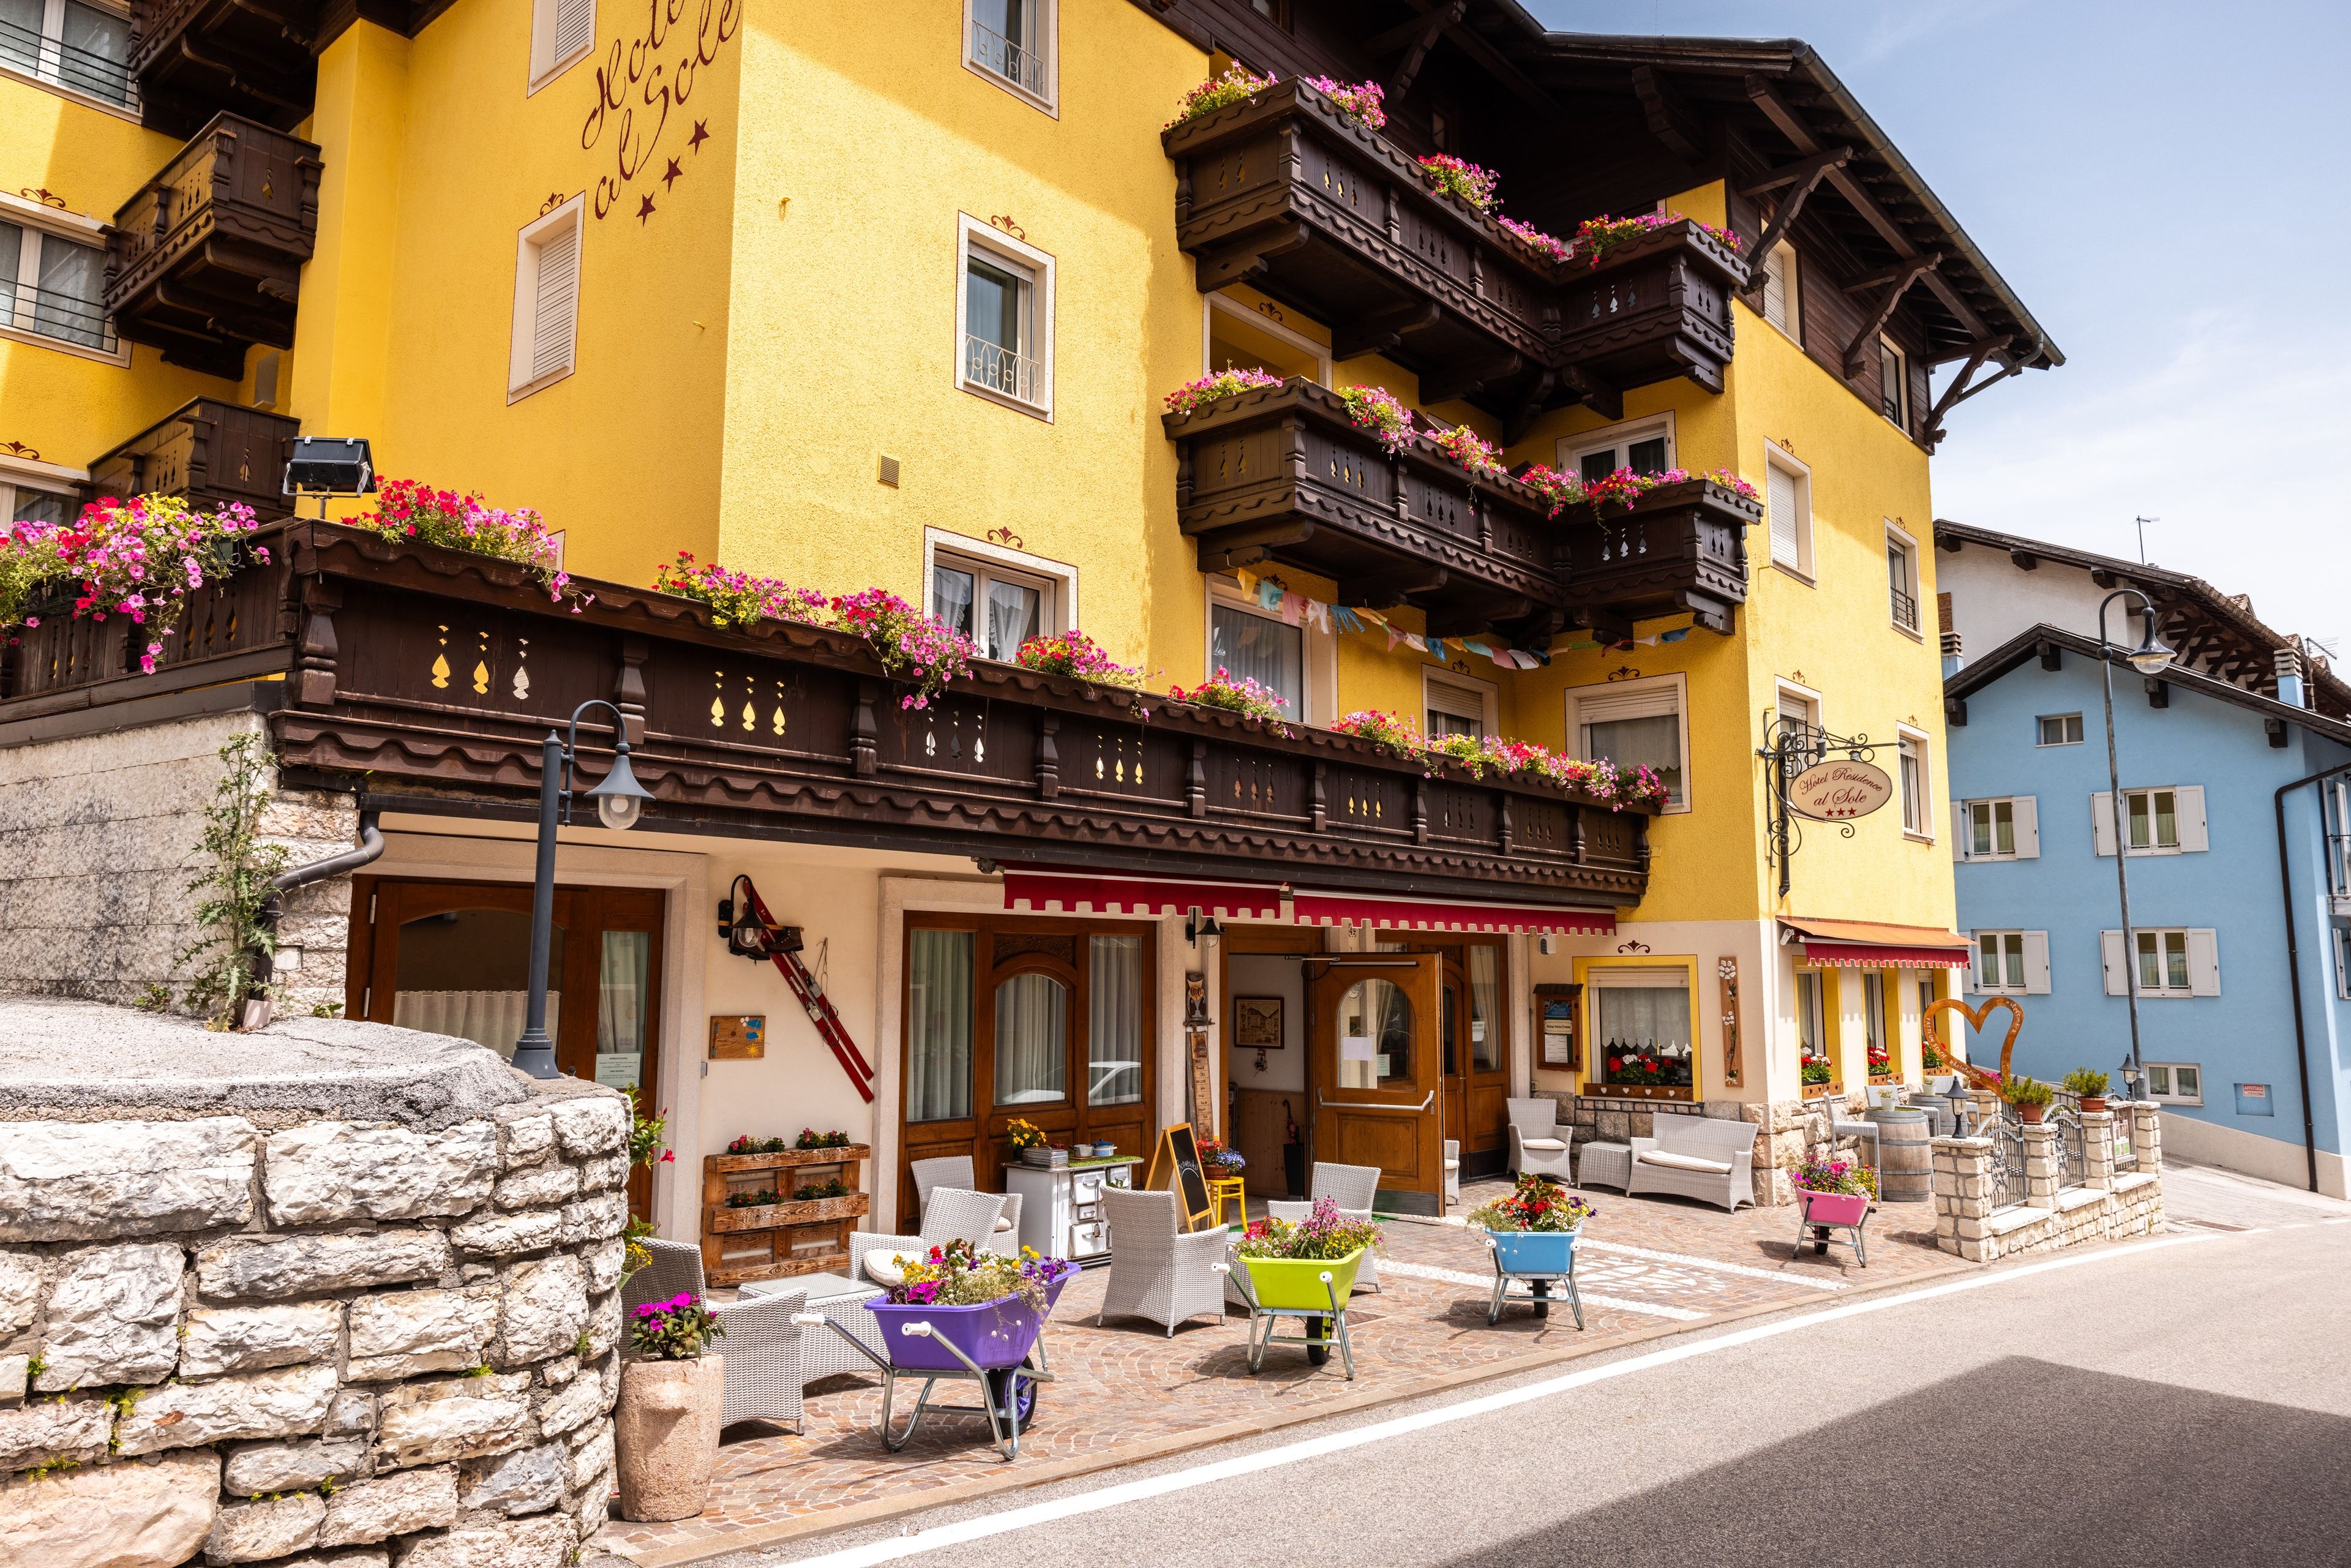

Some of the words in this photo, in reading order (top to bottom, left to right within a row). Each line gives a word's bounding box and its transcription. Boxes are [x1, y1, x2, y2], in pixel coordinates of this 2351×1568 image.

[595, 108, 640, 220] al
[637, 0, 742, 174] Sole
[1799, 772, 1829, 795] Hotel
[1832, 767, 1883, 792] Residence
[1813, 792, 1829, 806] al
[1832, 786, 1867, 808] Sole
[1932, 1043, 1948, 1059] SELFIE
